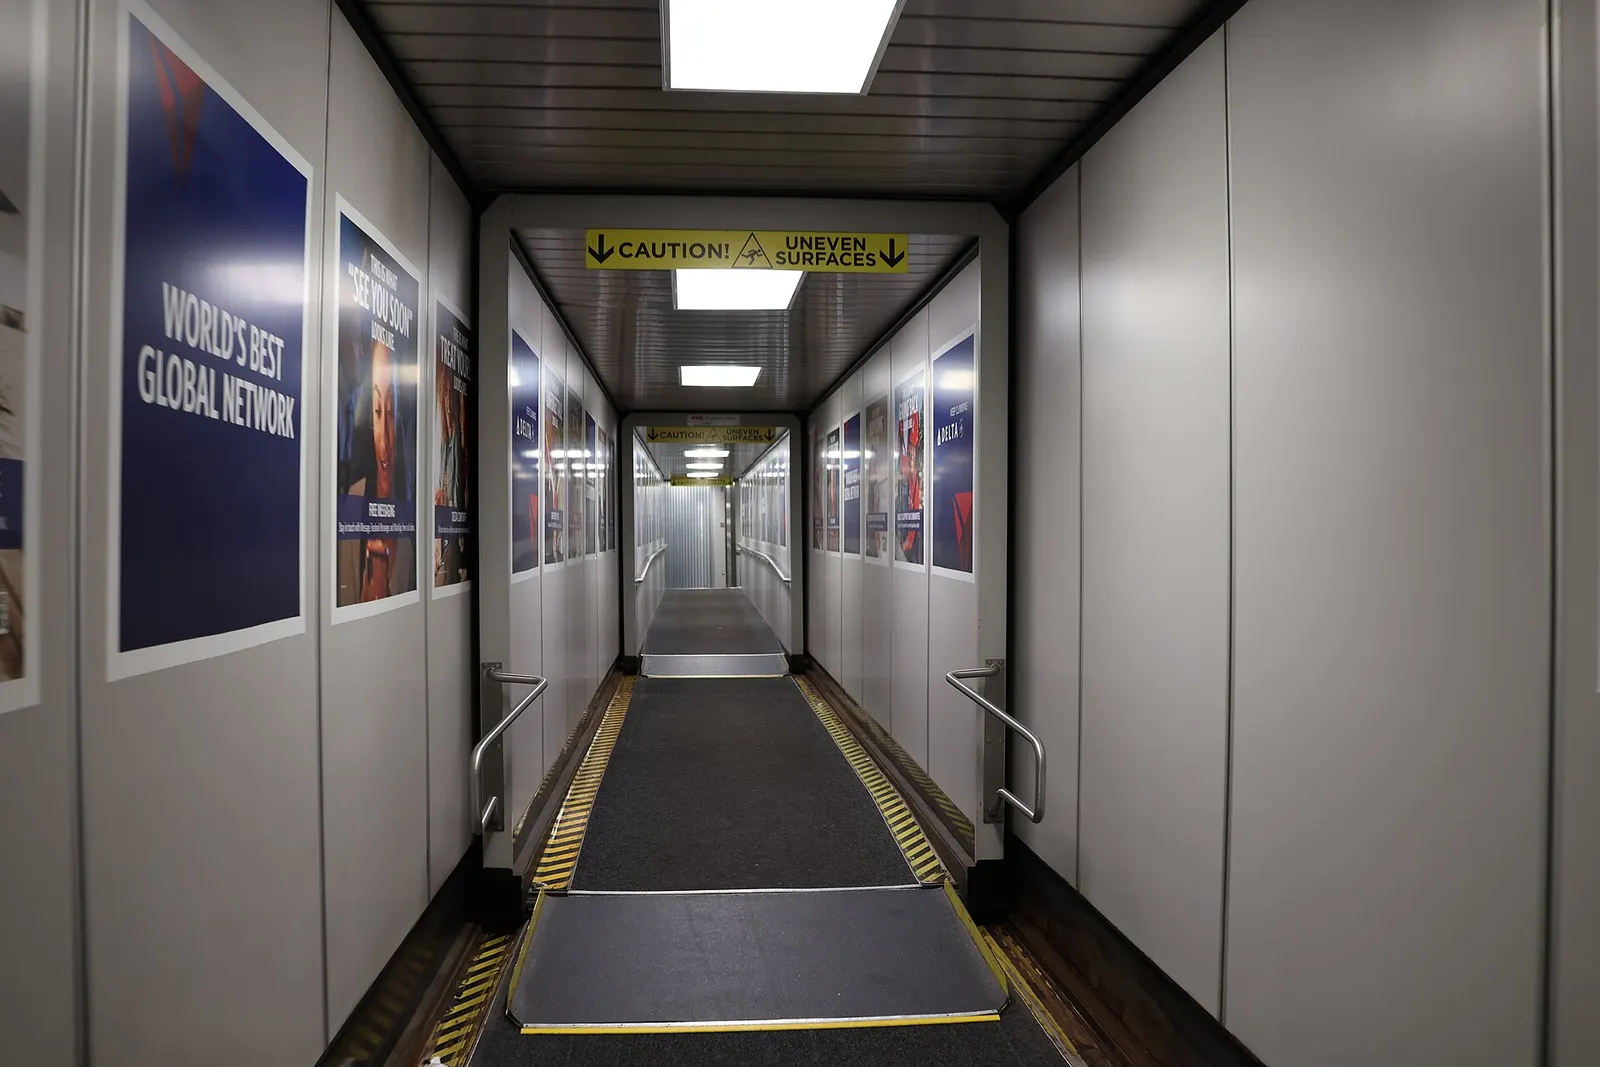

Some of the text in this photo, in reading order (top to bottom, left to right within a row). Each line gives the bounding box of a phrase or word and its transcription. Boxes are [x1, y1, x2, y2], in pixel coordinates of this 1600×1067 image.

[618, 241, 730, 260] CAUTION!
[785, 236, 867, 251] UNEVEN
[775, 251, 877, 267] SURFACES
[371, 278, 389, 324] YOU
[162, 281, 285, 382] WORLD'S BEST
[137, 344, 296, 440] GLOBAL NETWORK
[659, 431, 705, 440] CAUTION!
[941, 421, 959, 444] DELTA
